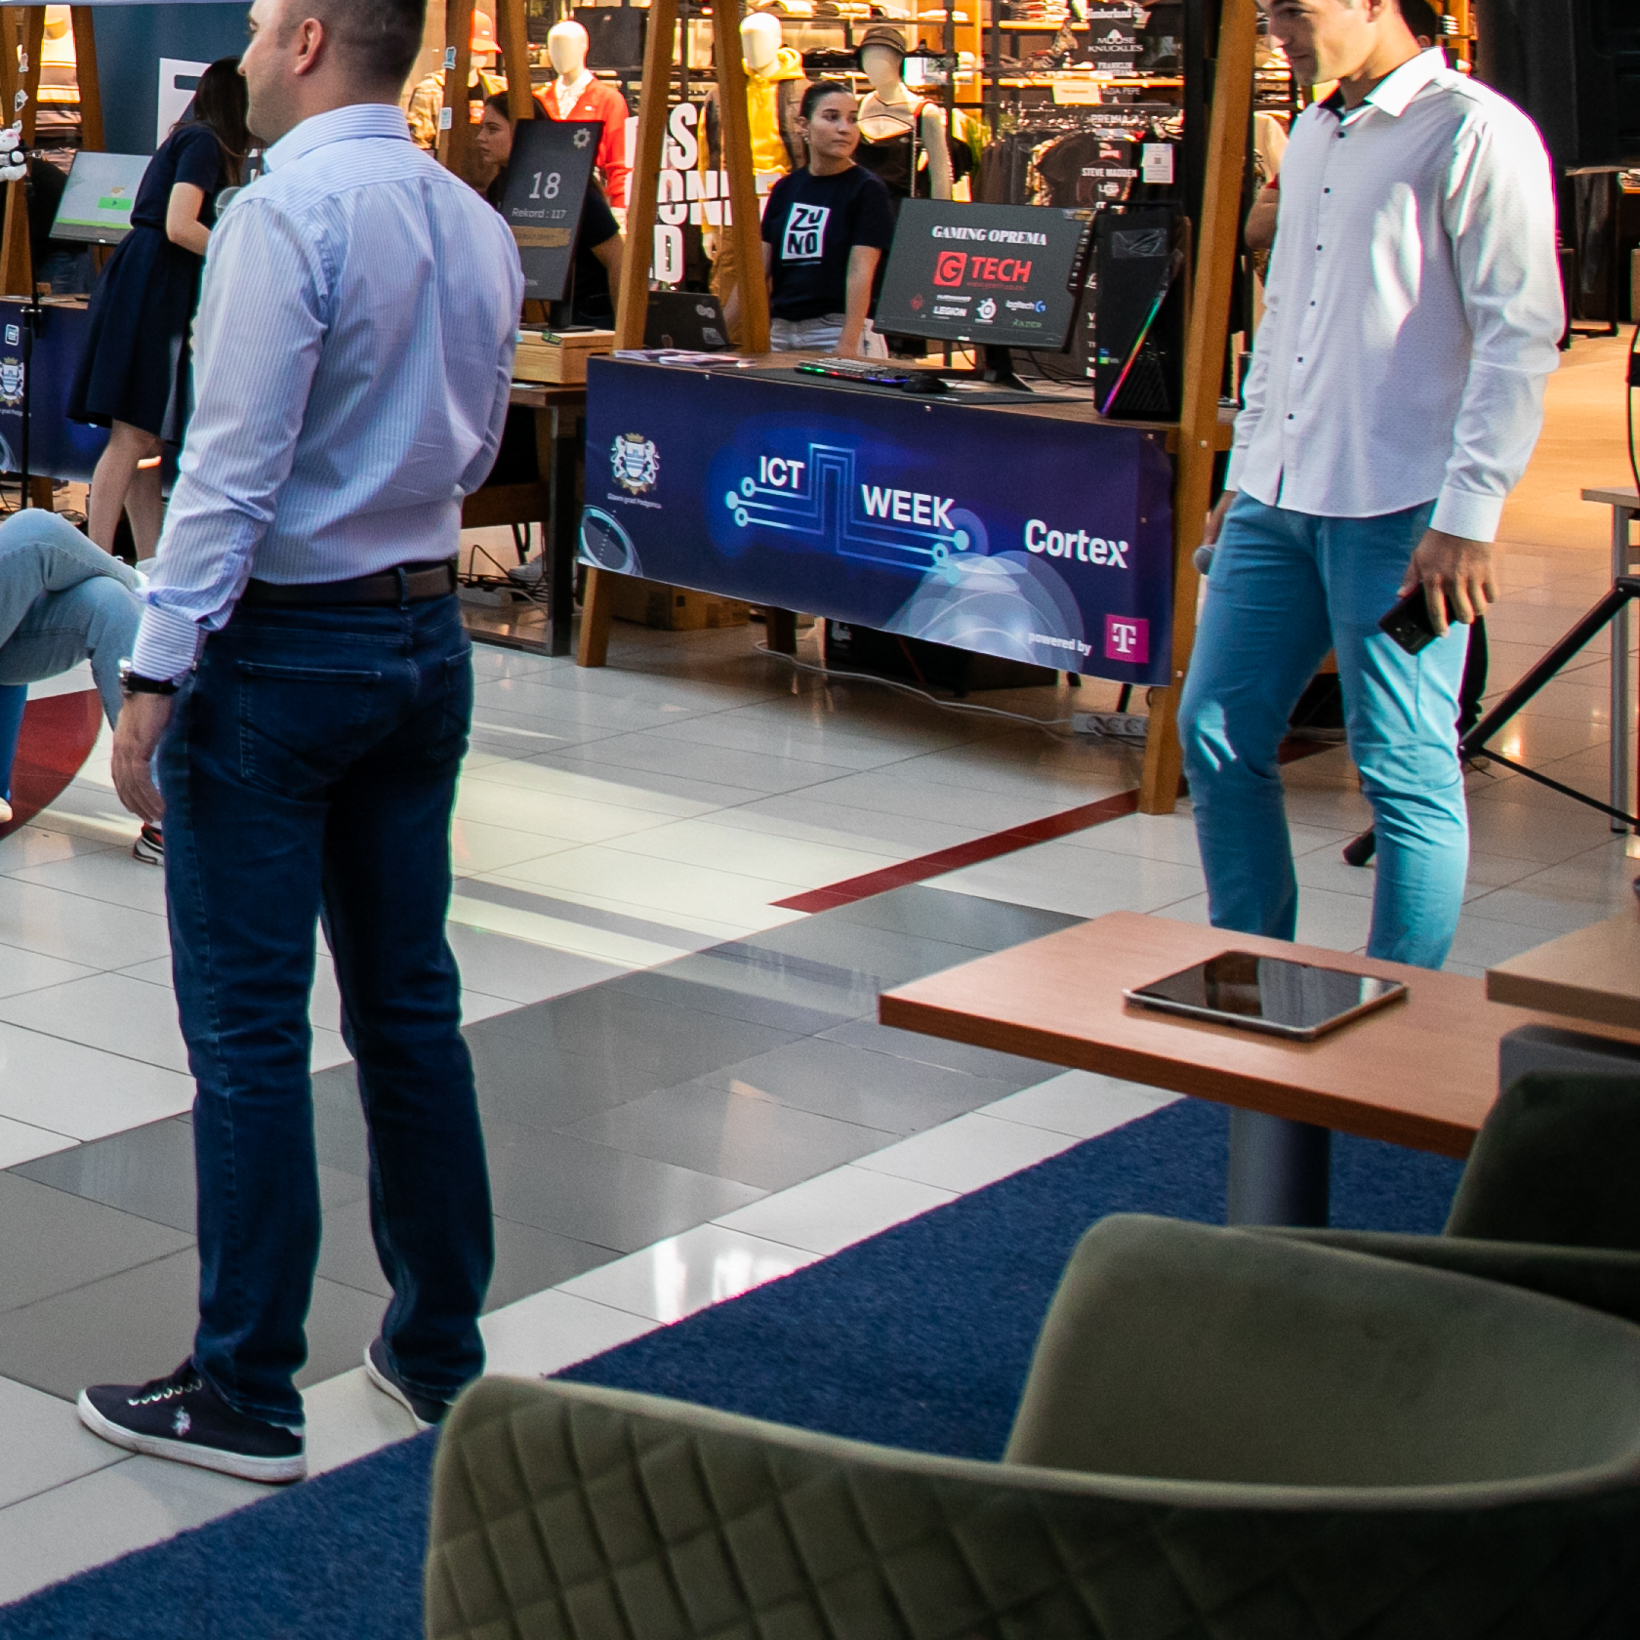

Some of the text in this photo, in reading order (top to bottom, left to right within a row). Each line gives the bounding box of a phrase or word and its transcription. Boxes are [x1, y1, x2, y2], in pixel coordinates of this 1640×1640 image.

[529, 172, 561, 199] 18
[512, 207, 544, 218] Rekord
[932, 226, 1046, 245] GAMING OPREMA
[971, 256, 1032, 283] TECH
[933, 306, 967, 317] LEGION
[759, 456, 956, 530] ICT WEEK
[1025, 518, 1129, 570] Cortex
[1028, 631, 1072, 649] powered
[1075, 637, 1092, 656] by
